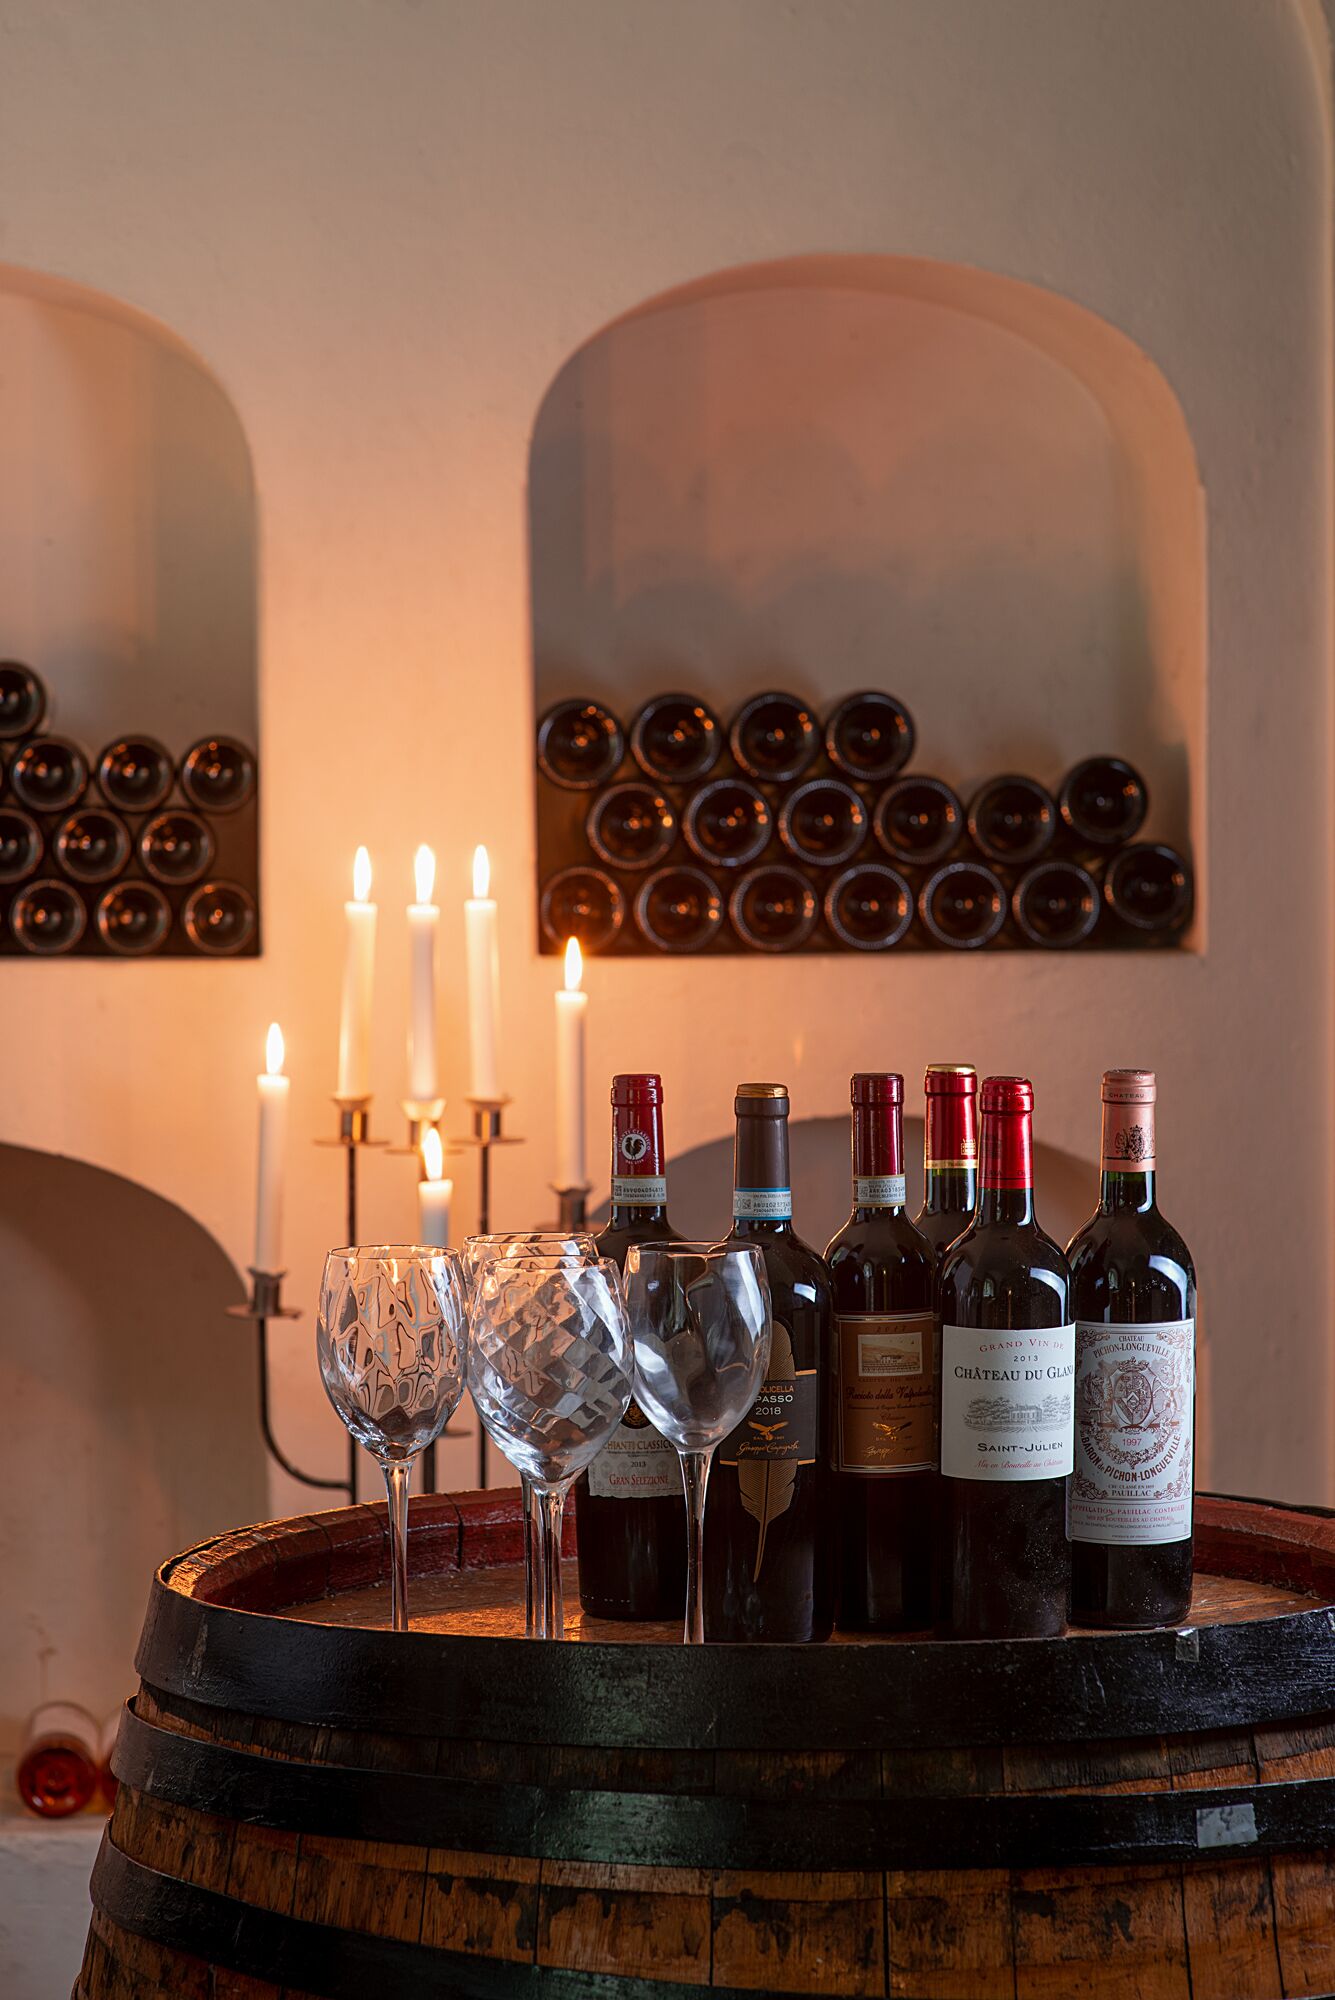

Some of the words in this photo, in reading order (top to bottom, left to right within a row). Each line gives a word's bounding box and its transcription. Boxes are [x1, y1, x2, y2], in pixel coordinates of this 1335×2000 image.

[979, 1341, 1023, 1353] GRAND
[1029, 1338, 1049, 1348] VIN
[1053, 1342, 1065, 1351] DE
[1093, 1341, 1171, 1359] PICHON-LONGUEVILLE
[1013, 1355, 1039, 1363] 2013
[954, 1366, 1022, 1381] CHÂTEAU
[1025, 1369, 1044, 1381] DU
[756, 1407, 782, 1415] 2018
[637, 1439, 675, 1450] CLASSICO
[977, 1442, 1064, 1453] SAINT-JULIEN
[1122, 1438, 1142, 1447] 1997
[1081, 1437, 1102, 1466] BARON
[609, 1474, 630, 1485] GRAN
[631, 1474, 669, 1486] SELEZIONE
